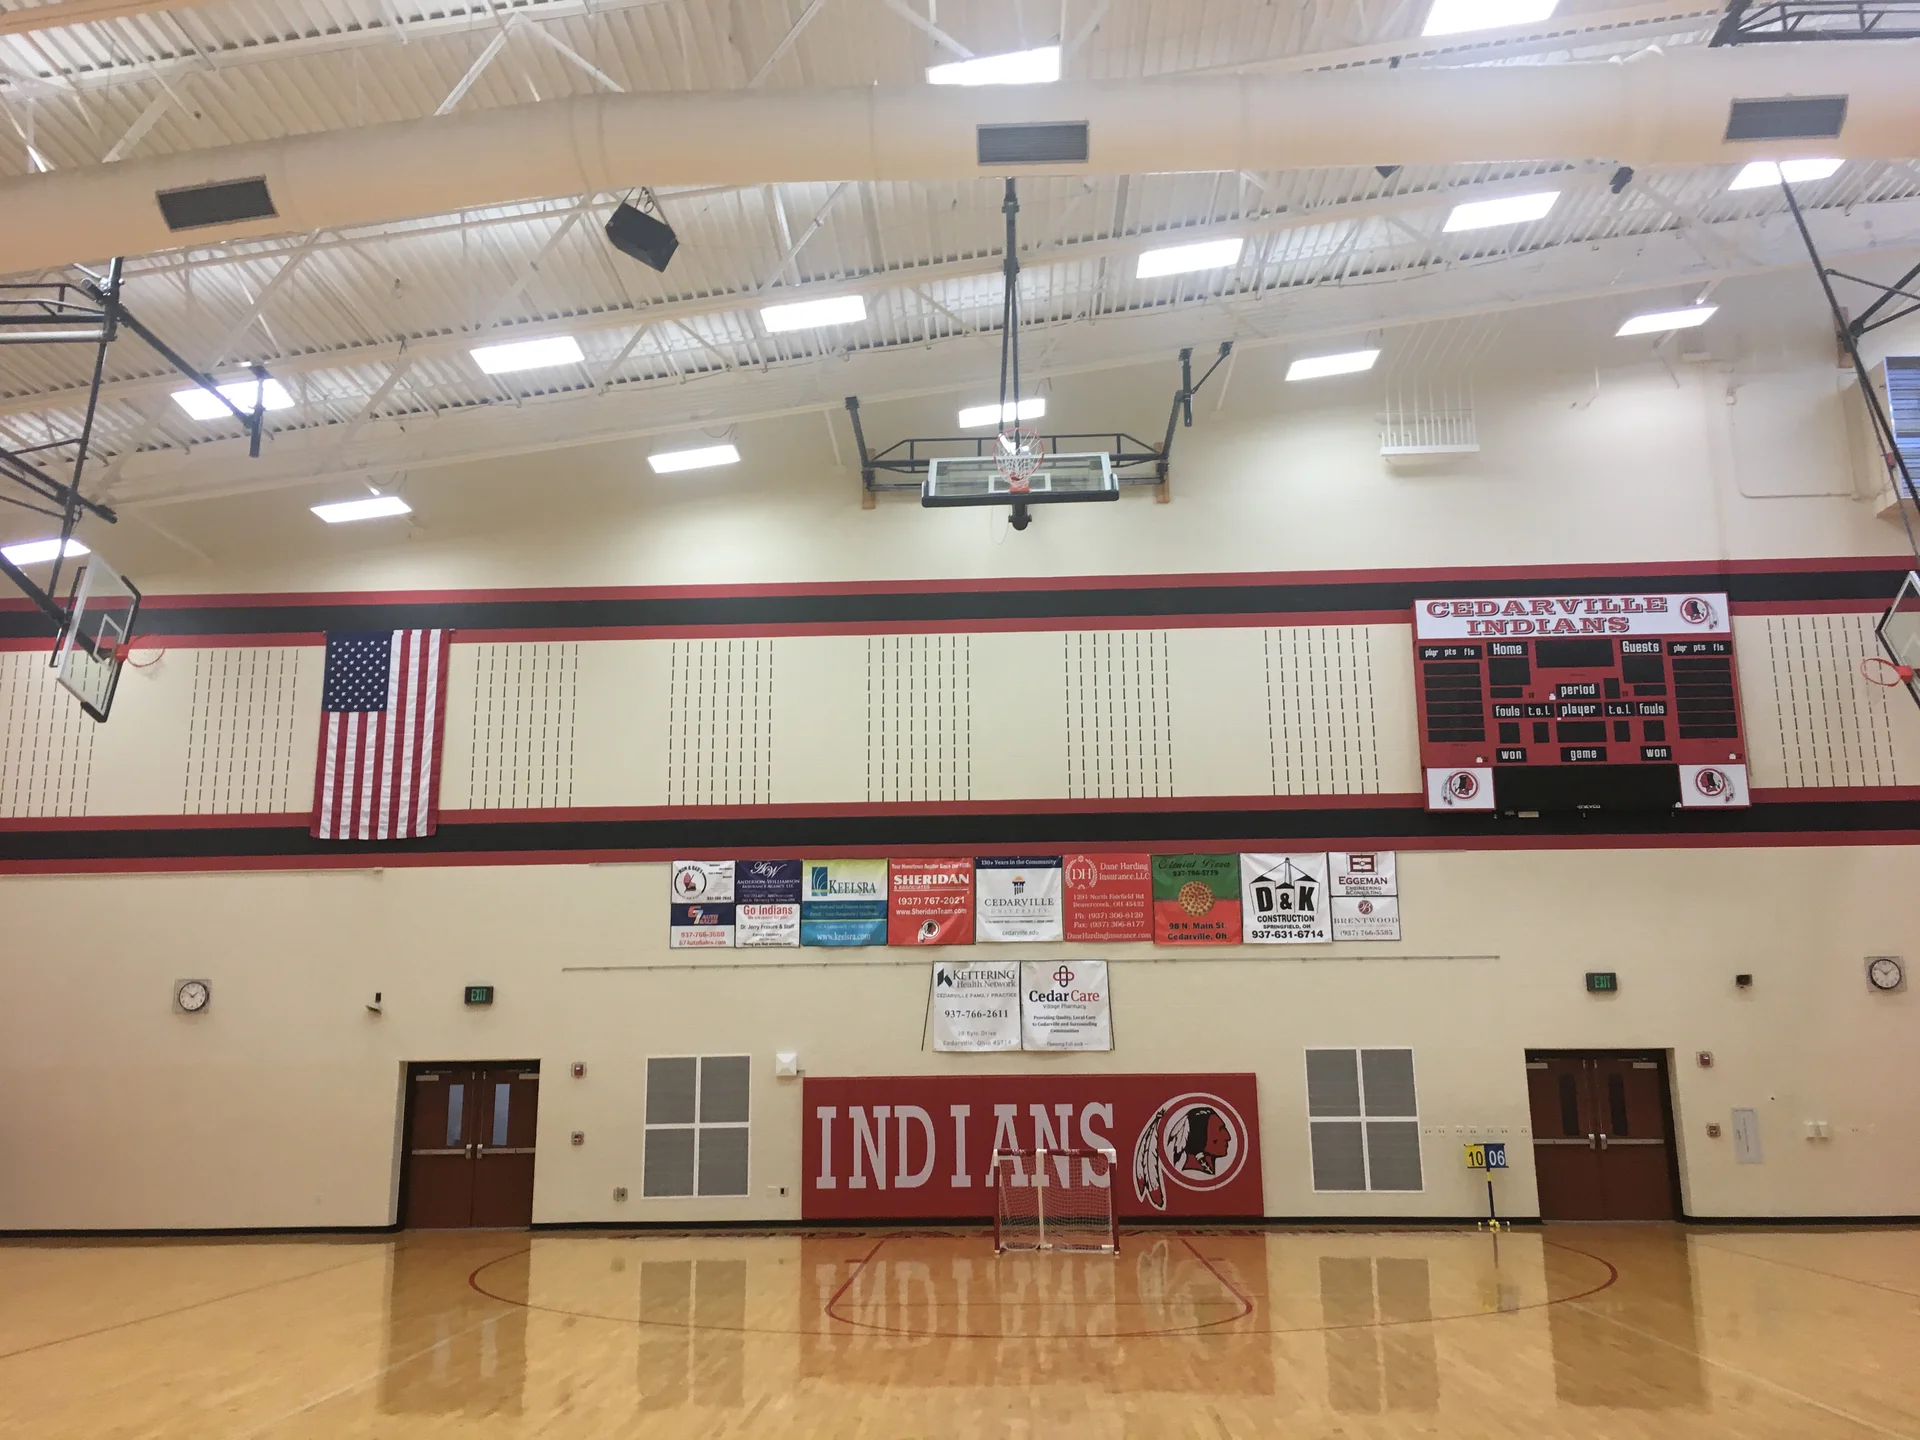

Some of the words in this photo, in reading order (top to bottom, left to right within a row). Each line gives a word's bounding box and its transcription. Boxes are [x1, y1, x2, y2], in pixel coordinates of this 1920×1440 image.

[1426, 597, 1668, 617] CEDARVILLE
[1466, 616, 1630, 636] INDIANS
[1493, 643, 1522, 655] Home
[1622, 640, 1660, 653] Guests
[1560, 684, 1595, 697] period
[1495, 705, 1521, 717] fouls
[1561, 703, 1596, 717] player
[1639, 703, 1665, 714] fouls
[1501, 750, 1522, 760] won
[1570, 748, 1597, 761] game
[1646, 748, 1667, 758] won
[1100, 862, 1118, 870] Dane
[1120, 862, 1148, 871] Harding
[1072, 868, 1091, 880] DH
[893, 874, 969, 885] SHERIDAN
[1338, 876, 1388, 885] EGGEMAN
[898, 897, 922, 905] (937)
[924, 896, 965, 905] 767-2021
[984, 898, 1055, 907] CEDARVILLE
[743, 905, 756, 915] Go
[759, 905, 793, 915] Indians
[895, 907, 967, 915] www.SheridanTeam.com
[1257, 914, 1315, 923] CONSTRUCTION
[1333, 917, 1398, 925] BRENTWOOD
[816, 932, 871, 941] www.keelsra.com
[1066, 932, 1152, 940] DaneHardingInsurance.com
[1251, 930, 1324, 938] 937-631-6714
[953, 970, 1016, 980] KETTERING
[957, 980, 982, 988] Health
[984, 979, 1016, 988] Network
[1594, 975, 1611, 988] EXIT
[471, 988, 487, 1001] EXIT
[944, 1009, 1008, 1018] 937-766-2611
[816, 1101, 1114, 1190] INDIANS
[1468, 1150, 1484, 1166] 10
[1488, 1149, 1505, 1166] 06
